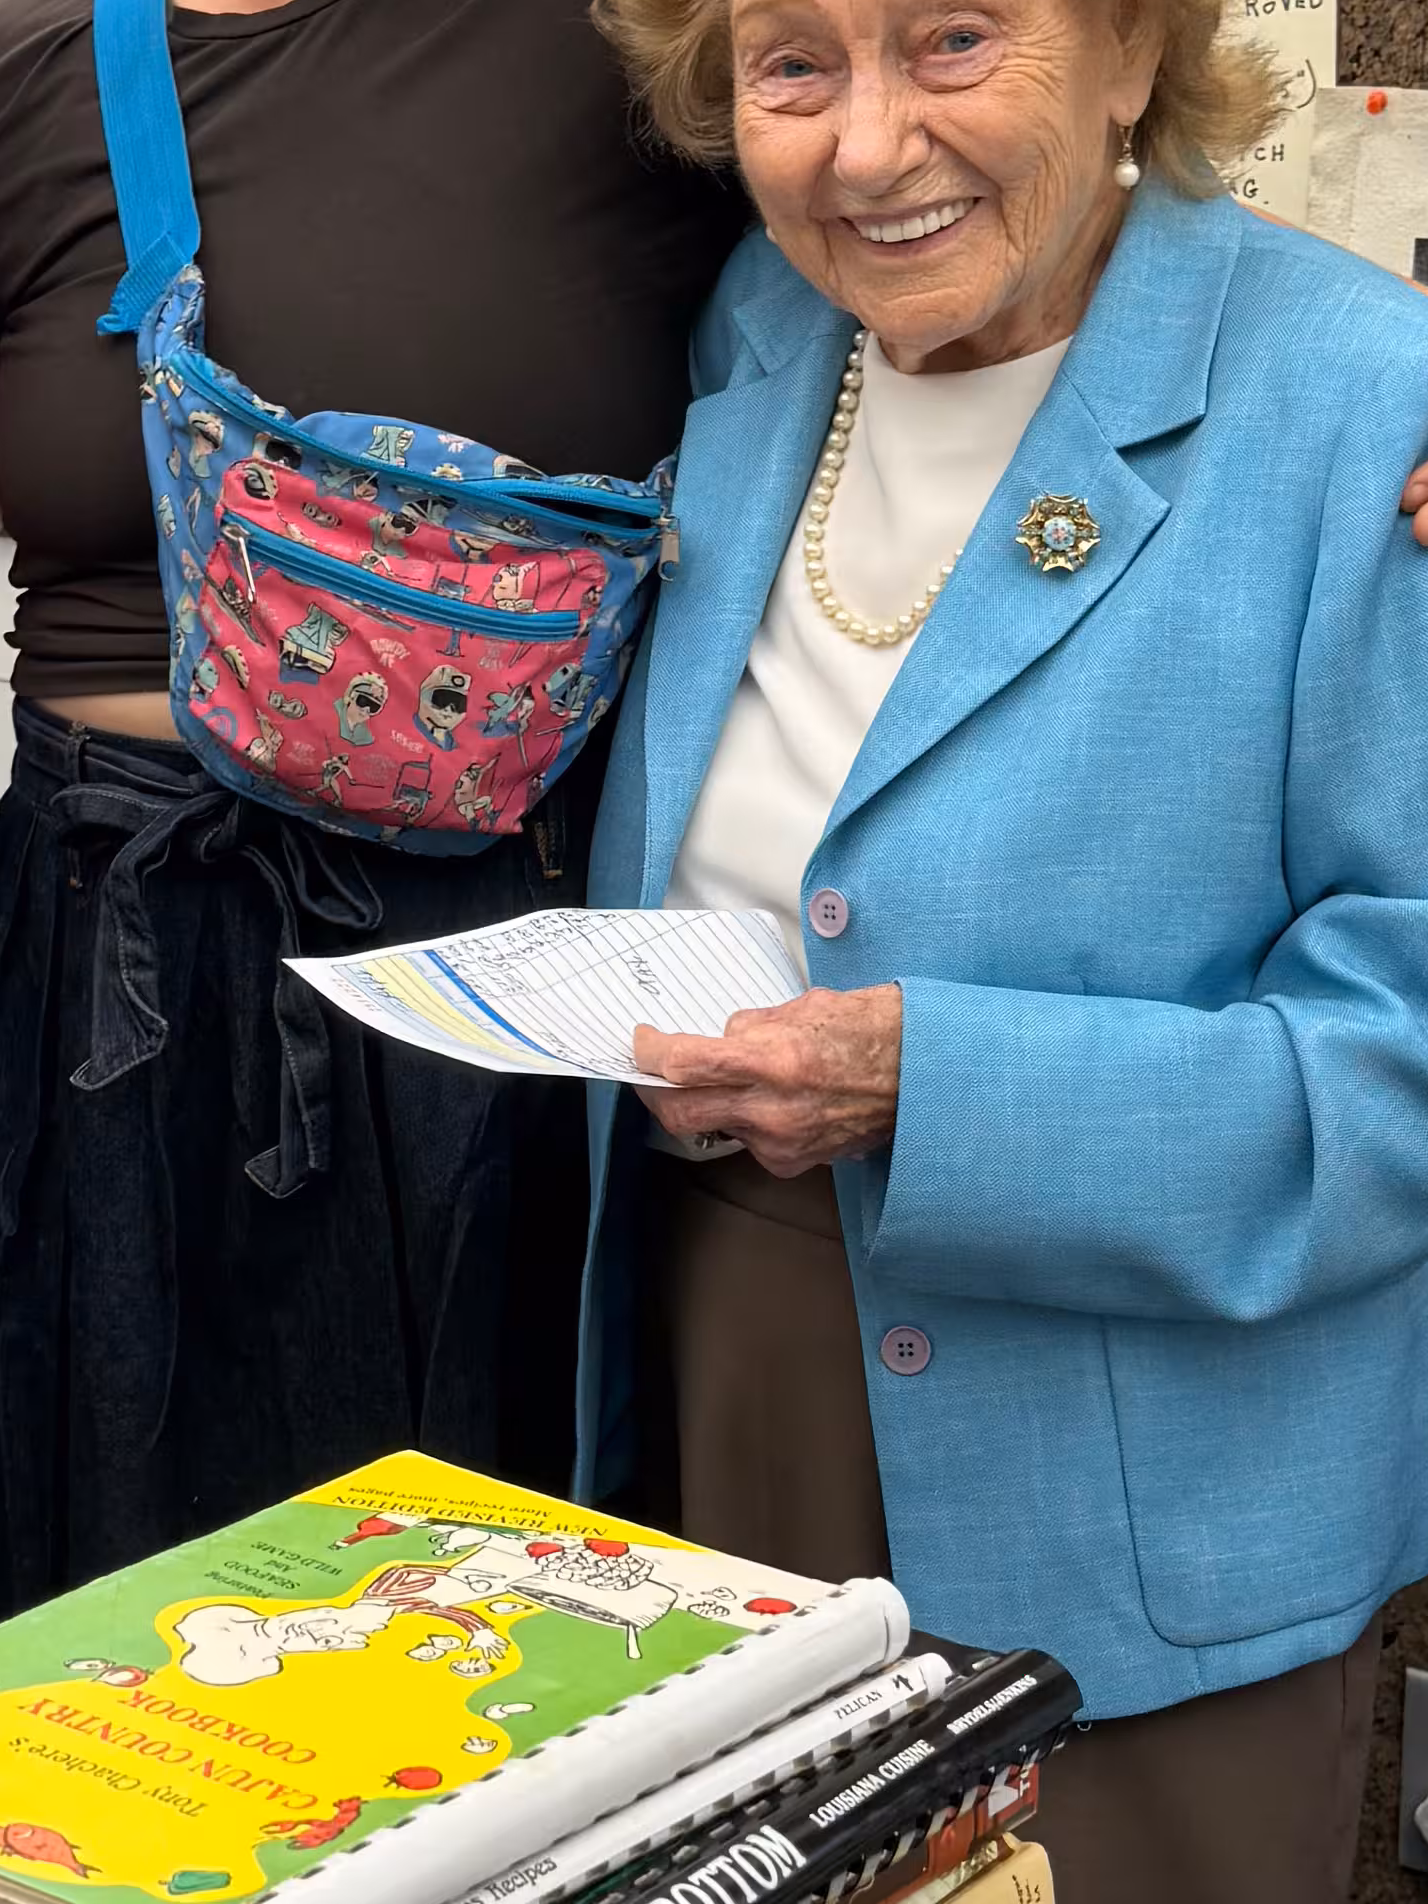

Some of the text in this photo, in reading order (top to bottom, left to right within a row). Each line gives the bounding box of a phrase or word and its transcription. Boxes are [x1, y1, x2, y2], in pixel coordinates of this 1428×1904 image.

[332, 1493, 606, 1536] NEW REVISED EDITION
[347, 1486, 551, 1519] More more pages
[223, 1558, 301, 1593] SEAFOOD
[250, 1539, 344, 1577] WILD GAME
[204, 1570, 274, 1600] Featuring
[116, 1687, 317, 1765] COOKBOOK
[8, 1733, 209, 1818] Tony Chachere's
[16, 1697, 319, 1811] CAJUN COUNTRY
[809, 1738, 936, 1829] LOUISIANA CUISINE
[487, 1856, 559, 1902] Recipes
